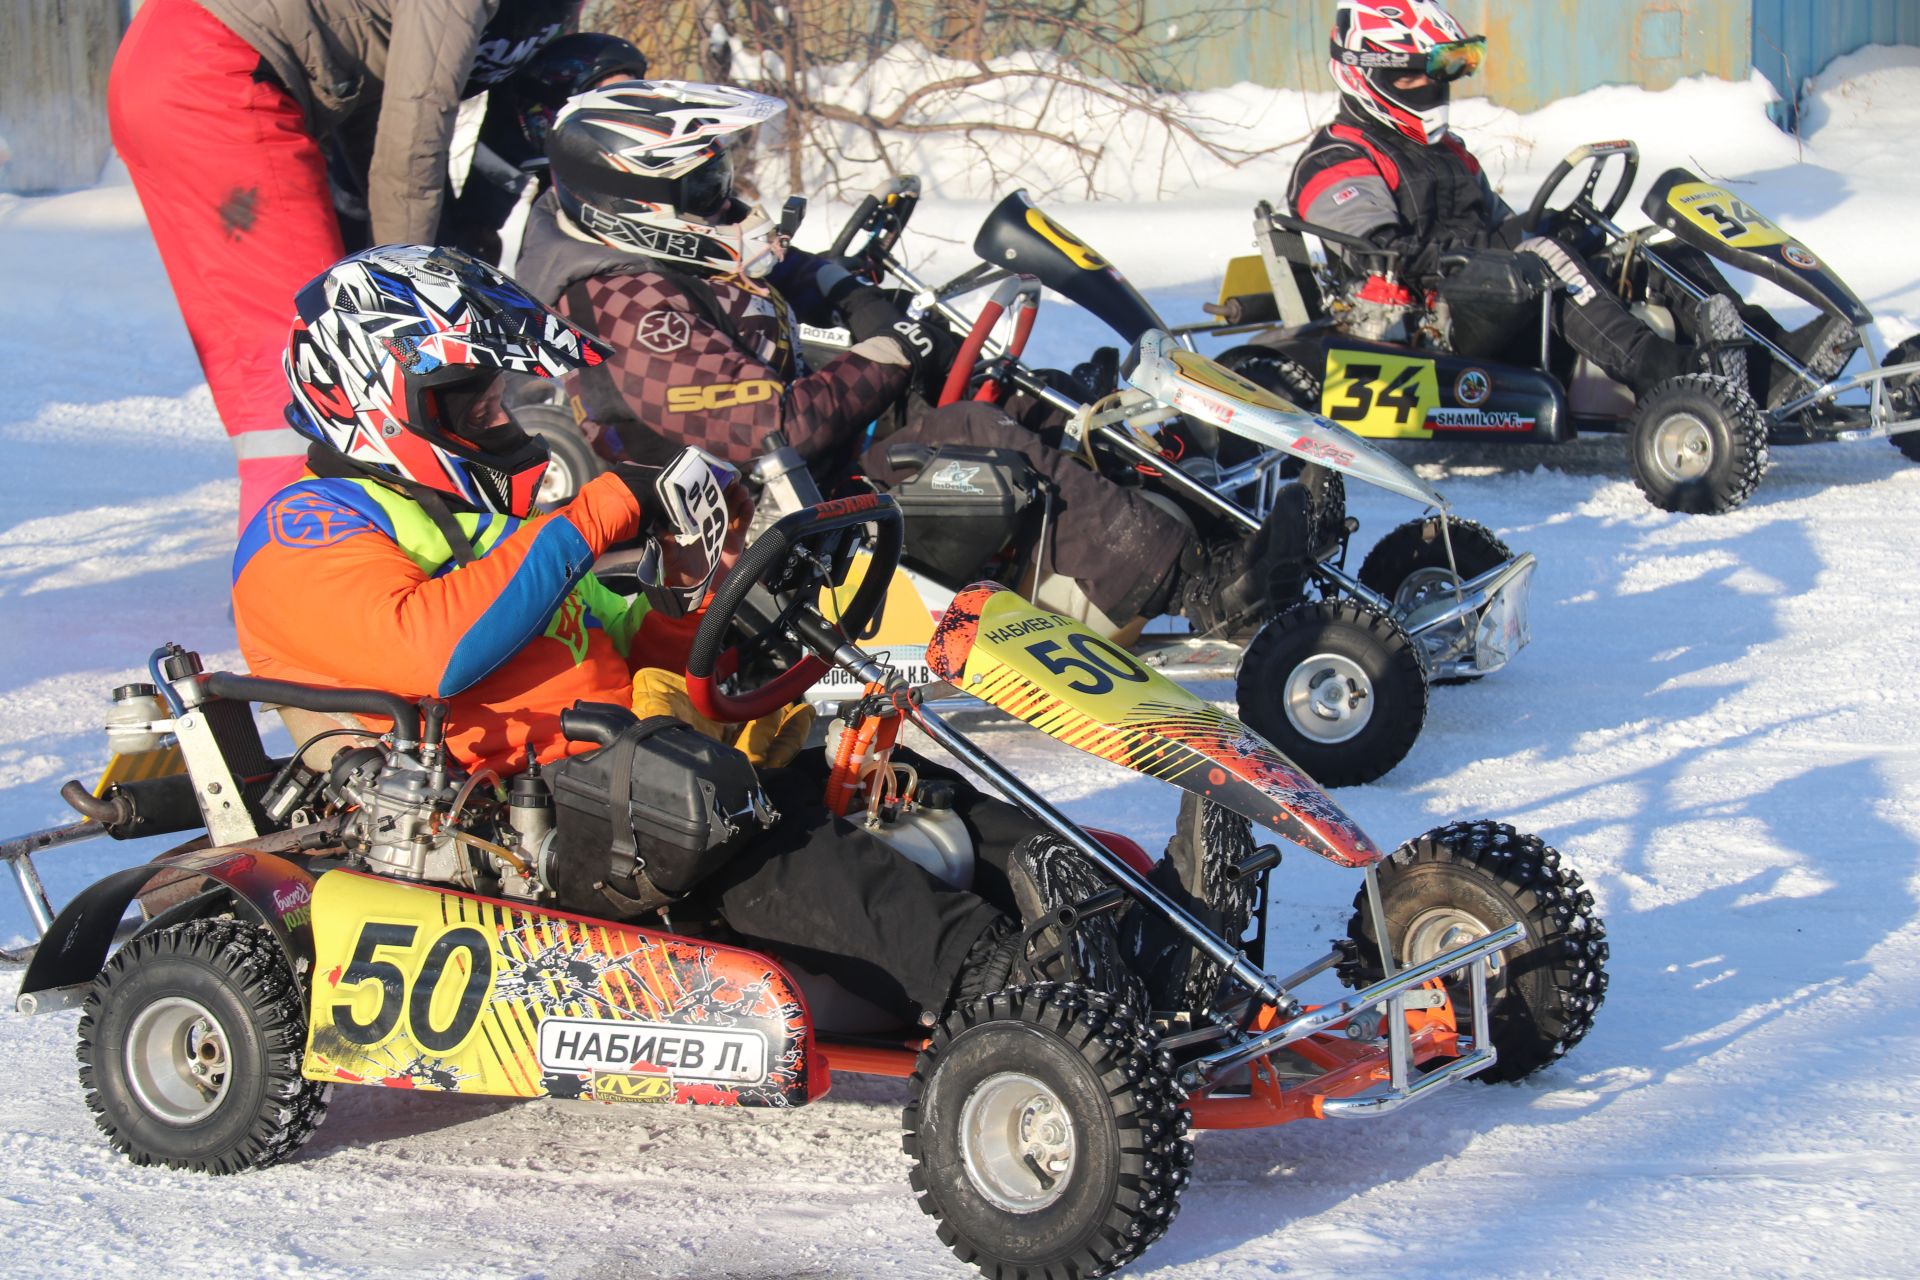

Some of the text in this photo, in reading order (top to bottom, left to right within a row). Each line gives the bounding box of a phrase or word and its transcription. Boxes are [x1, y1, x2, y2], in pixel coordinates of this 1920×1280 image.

[1360, 52, 1410, 63] SKY
[581, 203, 699, 258] FXR
[1696, 200, 1771, 240] 34
[803, 327, 845, 341] ROTAX
[1330, 364, 1425, 424] 34
[1437, 411, 1521, 427] SHAMILOV F.
[933, 482, 974, 492] InsDesign
[984, 617, 1055, 645] НАБИЕВ
[1024, 633, 1149, 695] 50
[332, 922, 492, 1052] 50
[555, 1030, 748, 1073] НАБИЕВ Л.
